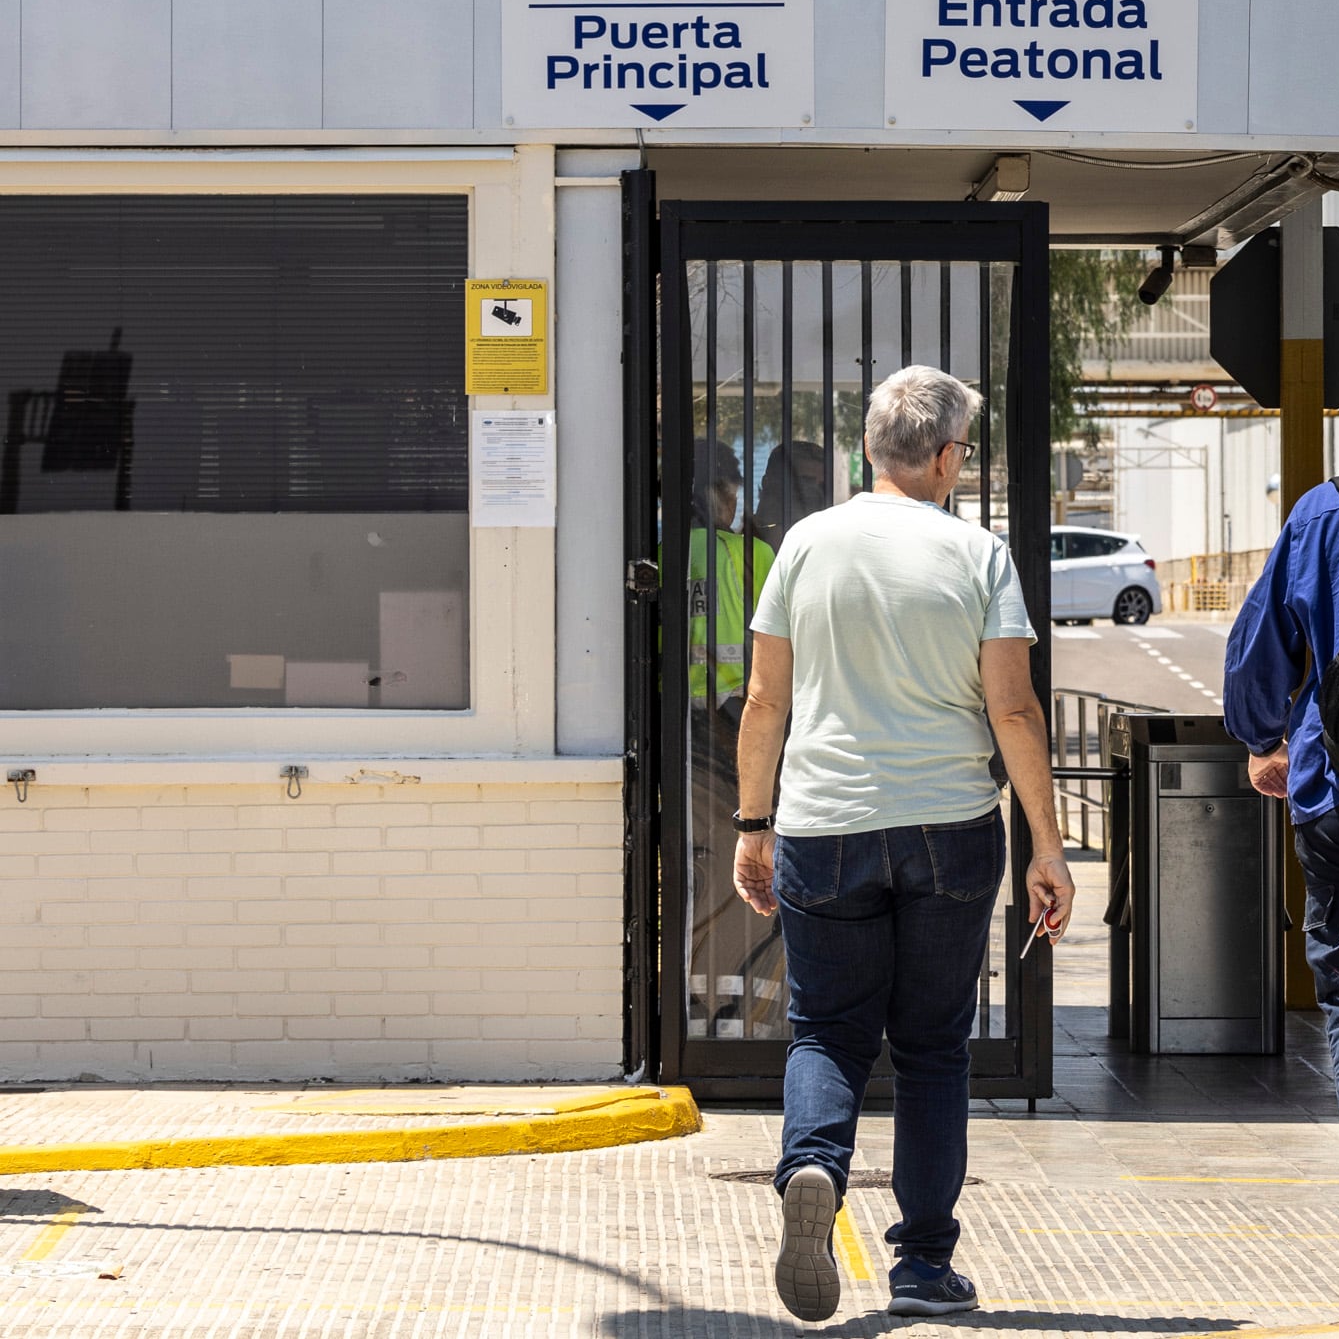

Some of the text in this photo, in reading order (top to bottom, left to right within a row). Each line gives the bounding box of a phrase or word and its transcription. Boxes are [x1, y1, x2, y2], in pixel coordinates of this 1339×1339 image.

[574, 15, 741, 49] Puerta
[547, 52, 769, 95] Principal
[922, 38, 1162, 80] Peatonal
